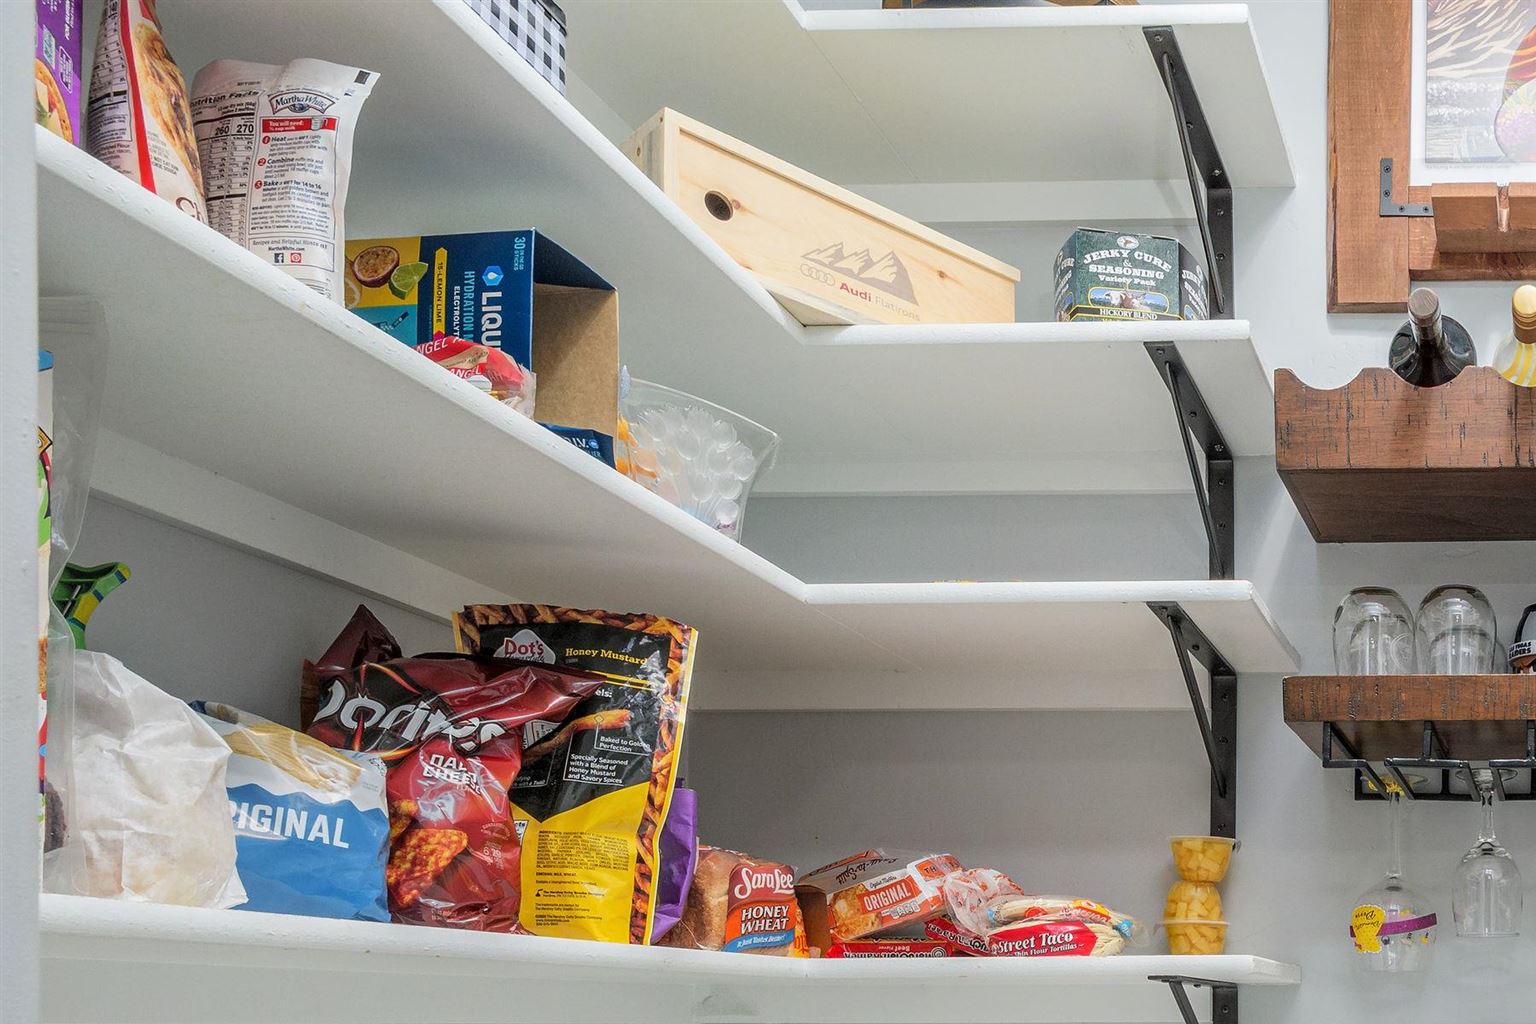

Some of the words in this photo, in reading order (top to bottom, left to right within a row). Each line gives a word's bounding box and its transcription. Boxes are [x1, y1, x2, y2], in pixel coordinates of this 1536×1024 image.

[236, 124, 254, 134] 270
[513, 236, 526, 249] 30
[1083, 249, 1130, 264] JERKY
[1134, 251, 1172, 272] CURE
[1123, 259, 1132, 268] &
[1088, 265, 1164, 280] SEASONING
[1098, 274, 1132, 285] Variety
[1134, 278, 1157, 287] Pack
[464, 271, 475, 334] HYDRATION
[840, 282, 872, 302] Audi
[875, 296, 920, 321] Flatirons
[453, 286, 461, 340] ELECTROLYT
[481, 291, 503, 350] LIQU
[1100, 308, 1133, 317] HICKORY
[1134, 312, 1158, 320] BLEND
[504, 638, 545, 656] Dot's
[565, 648, 599, 657] Honey
[600, 649, 649, 666] Mustard
[599, 743, 632, 752] Perfection
[600, 736, 620, 745] Baked
[570, 754, 598, 763] Specially
[599, 757, 628, 766] Seasoned
[589, 761, 609, 770] Blend
[568, 766, 589, 775] Honey
[590, 769, 616, 778] Mustard
[581, 774, 603, 784] Savory
[603, 777, 623, 785] Spices
[735, 869, 772, 899] Sara
[774, 869, 794, 895] Lee
[864, 882, 911, 911] ORIGINAL
[742, 905, 789, 921] HONEY
[741, 917, 789, 934] WHEAT
[999, 937, 1037, 954] Street
[1039, 932, 1074, 949] Taco
[1050, 942, 1078, 952] Tortillas
